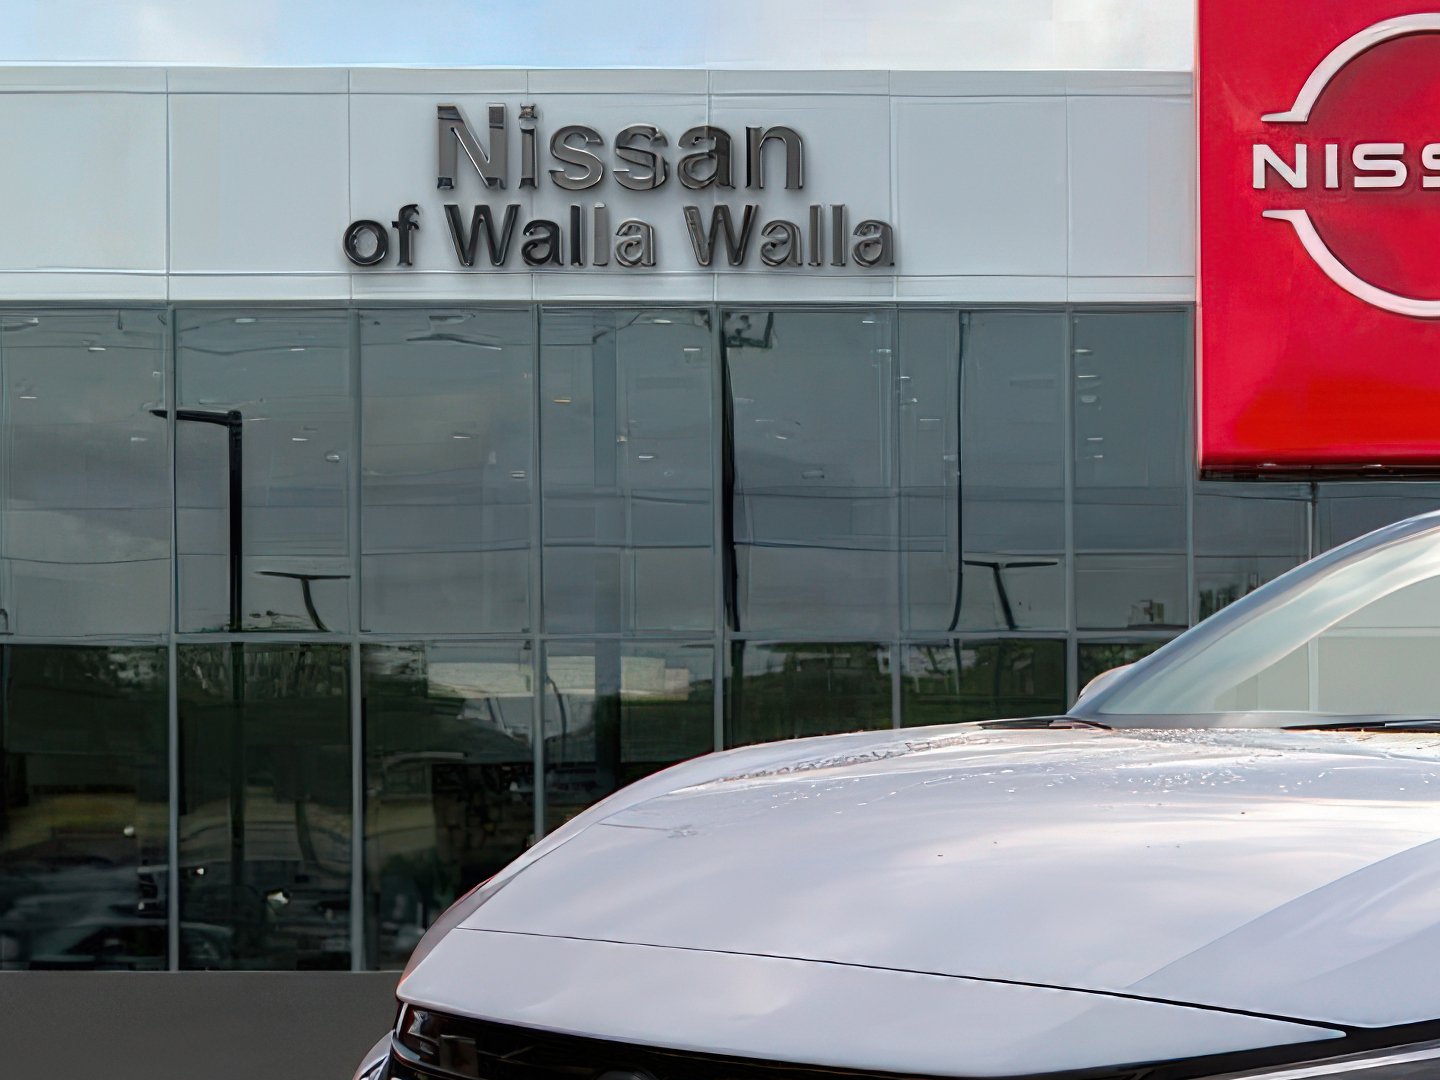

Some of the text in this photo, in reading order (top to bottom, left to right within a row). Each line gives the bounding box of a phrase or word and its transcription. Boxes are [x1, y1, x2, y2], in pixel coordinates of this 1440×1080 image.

[437, 103, 805, 190] Nissan
[342, 203, 896, 267] of Walla Walla
